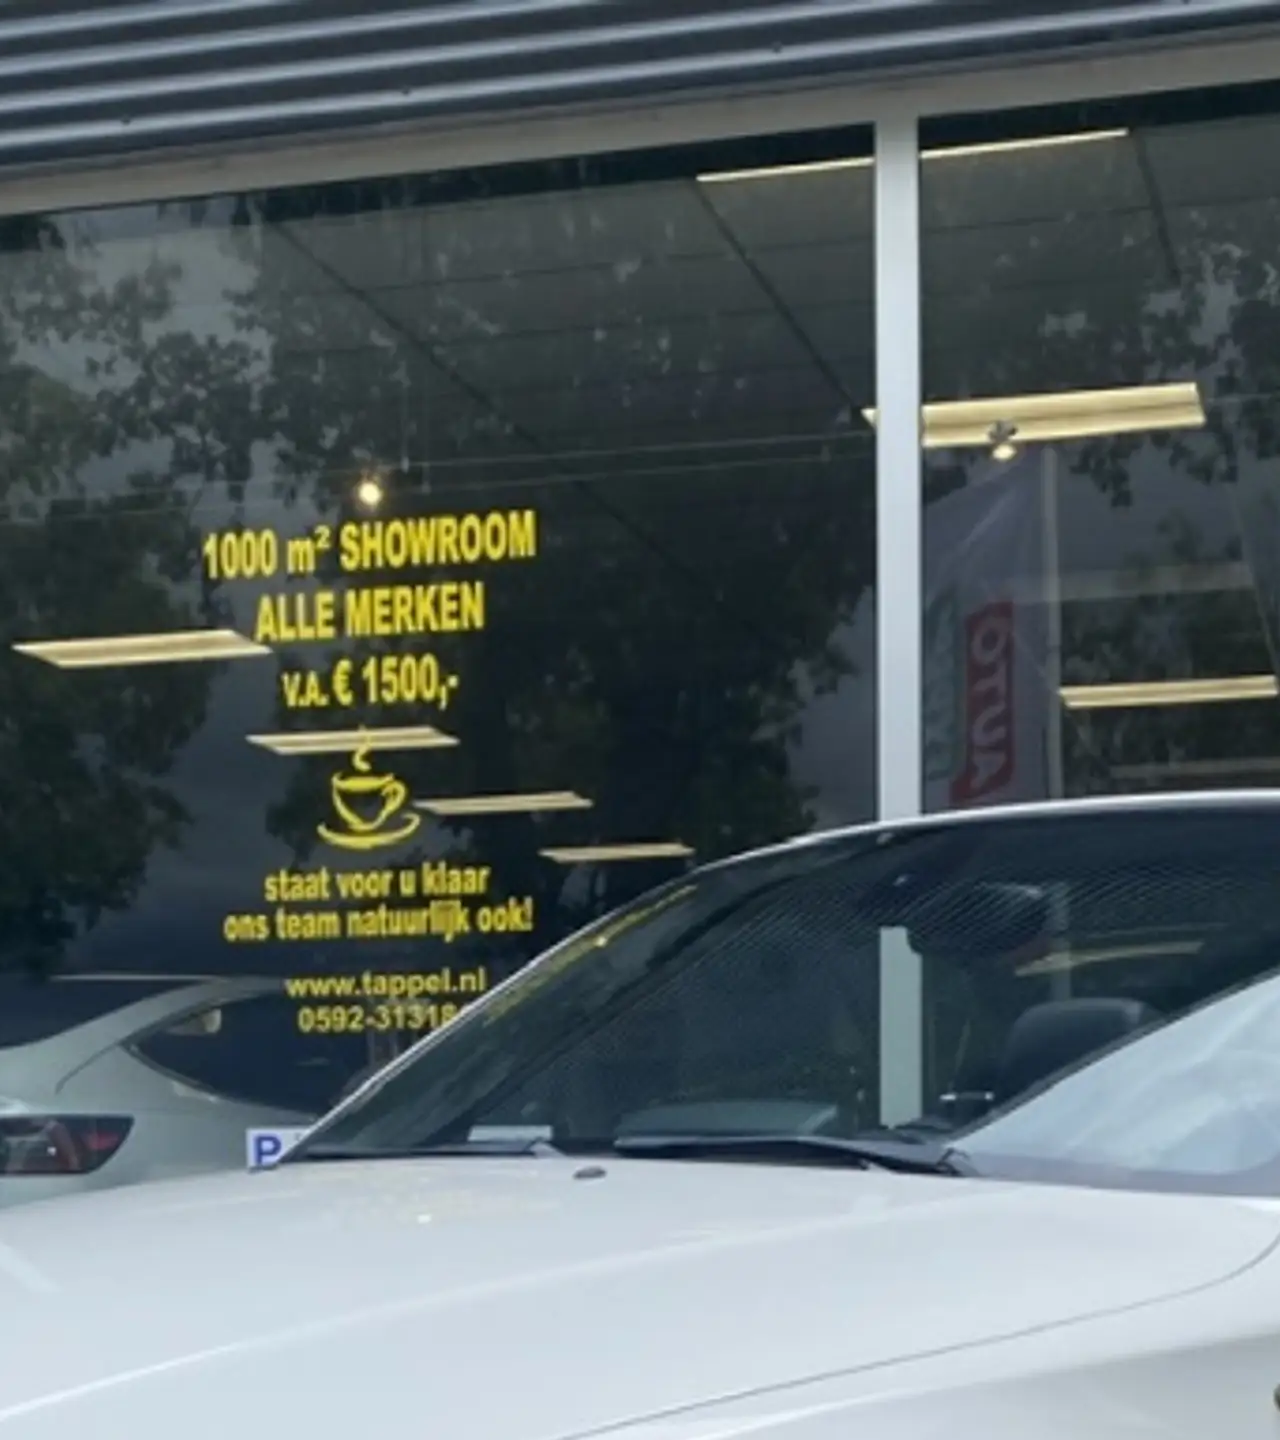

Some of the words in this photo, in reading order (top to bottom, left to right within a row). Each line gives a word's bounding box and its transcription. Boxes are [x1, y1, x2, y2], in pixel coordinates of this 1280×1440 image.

[203, 529, 277, 579] 1000
[339, 509, 536, 572] SHOWROOM
[255, 590, 335, 643] ALLE
[346, 581, 485, 637] MERKEN
[332, 659, 353, 706] €
[361, 653, 460, 711] 1500,-
[264, 867, 329, 901] staat
[336, 869, 394, 899] voor
[399, 869, 416, 895] u
[422, 861, 491, 895] klaar
[224, 912, 269, 941] ons
[275, 907, 340, 939] team
[346, 899, 470, 942] natuurlijk
[476, 896, 534, 932] ook!
[284, 967, 487, 999] www.tappel.nl
[297, 1002, 460, 1033] 0592-31318
